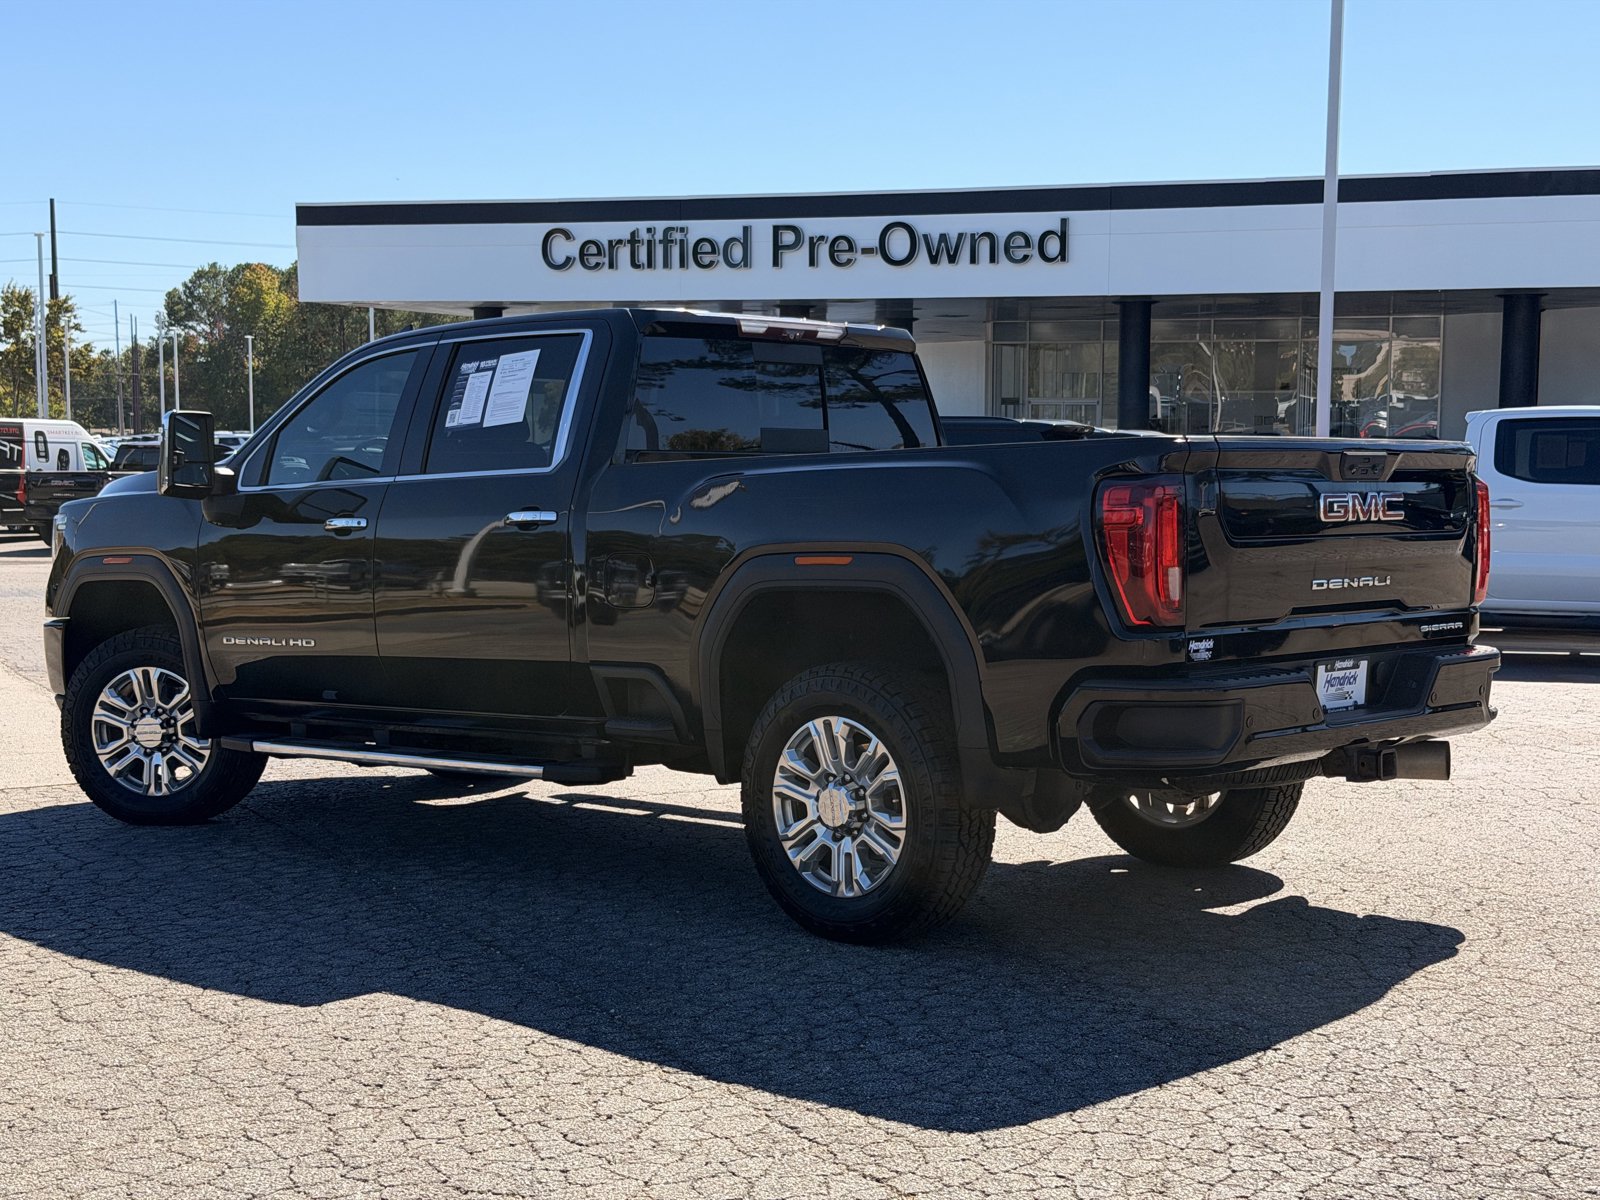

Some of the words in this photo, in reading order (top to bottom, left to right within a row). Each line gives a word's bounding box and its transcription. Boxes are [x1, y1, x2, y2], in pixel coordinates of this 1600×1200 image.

[541, 224, 752, 271] Certified
[772, 217, 1070, 270] Pre-Owned
[1319, 492, 1405, 522] GMC
[1312, 576, 1391, 591] DENALI
[1420, 622, 1463, 632] SIERRA
[222, 636, 286, 646] DENALI
[289, 638, 315, 647] HD
[1323, 670, 1359, 693] Hendrick
